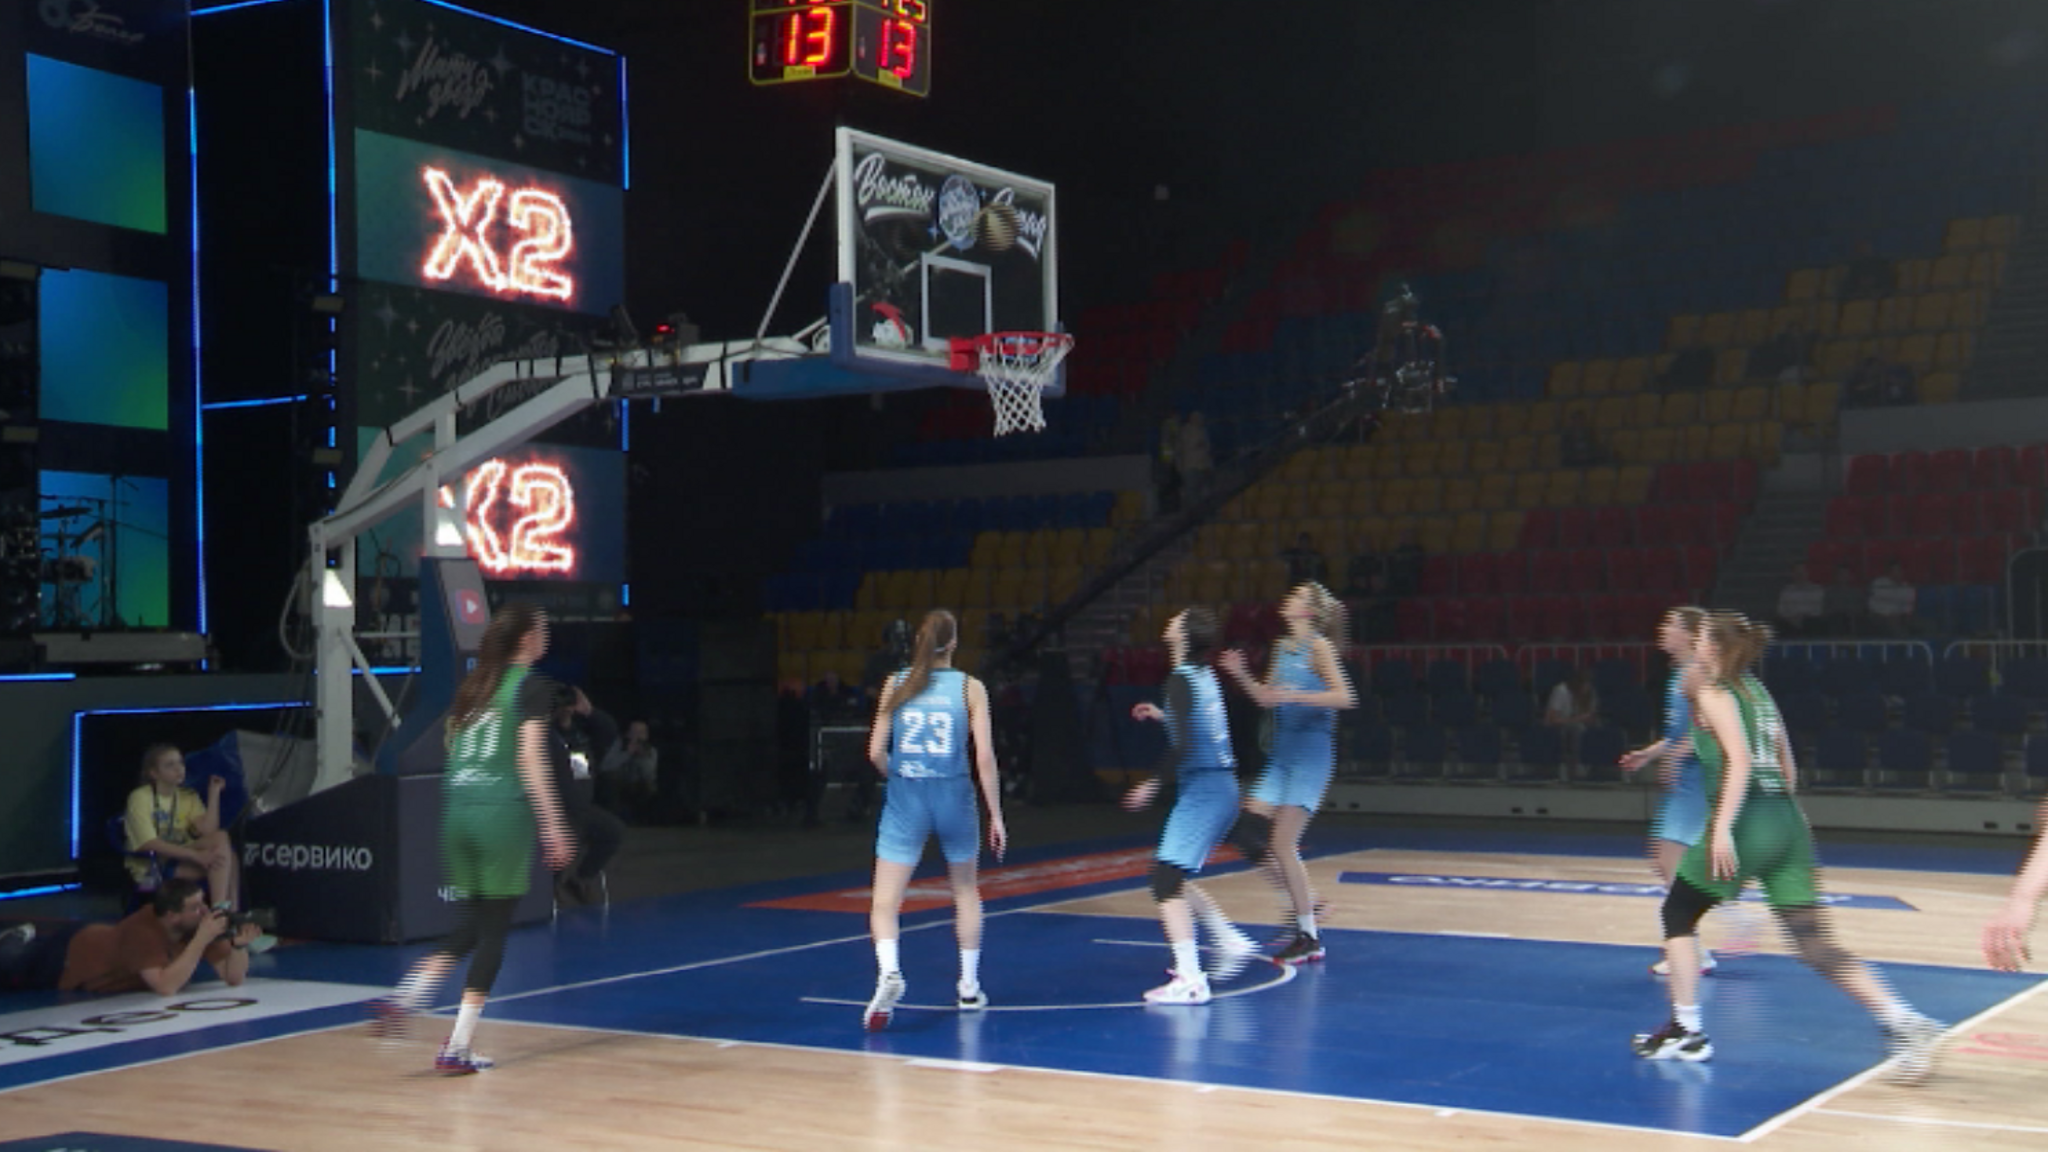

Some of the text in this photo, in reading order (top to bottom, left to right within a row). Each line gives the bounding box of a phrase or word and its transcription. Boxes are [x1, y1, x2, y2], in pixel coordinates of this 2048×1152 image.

[786, 7, 835, 65] 13
[880, 19, 917, 78] 13
[424, 164, 575, 300] X2
[898, 710, 955, 755] 23
[261, 842, 373, 871] сервико
